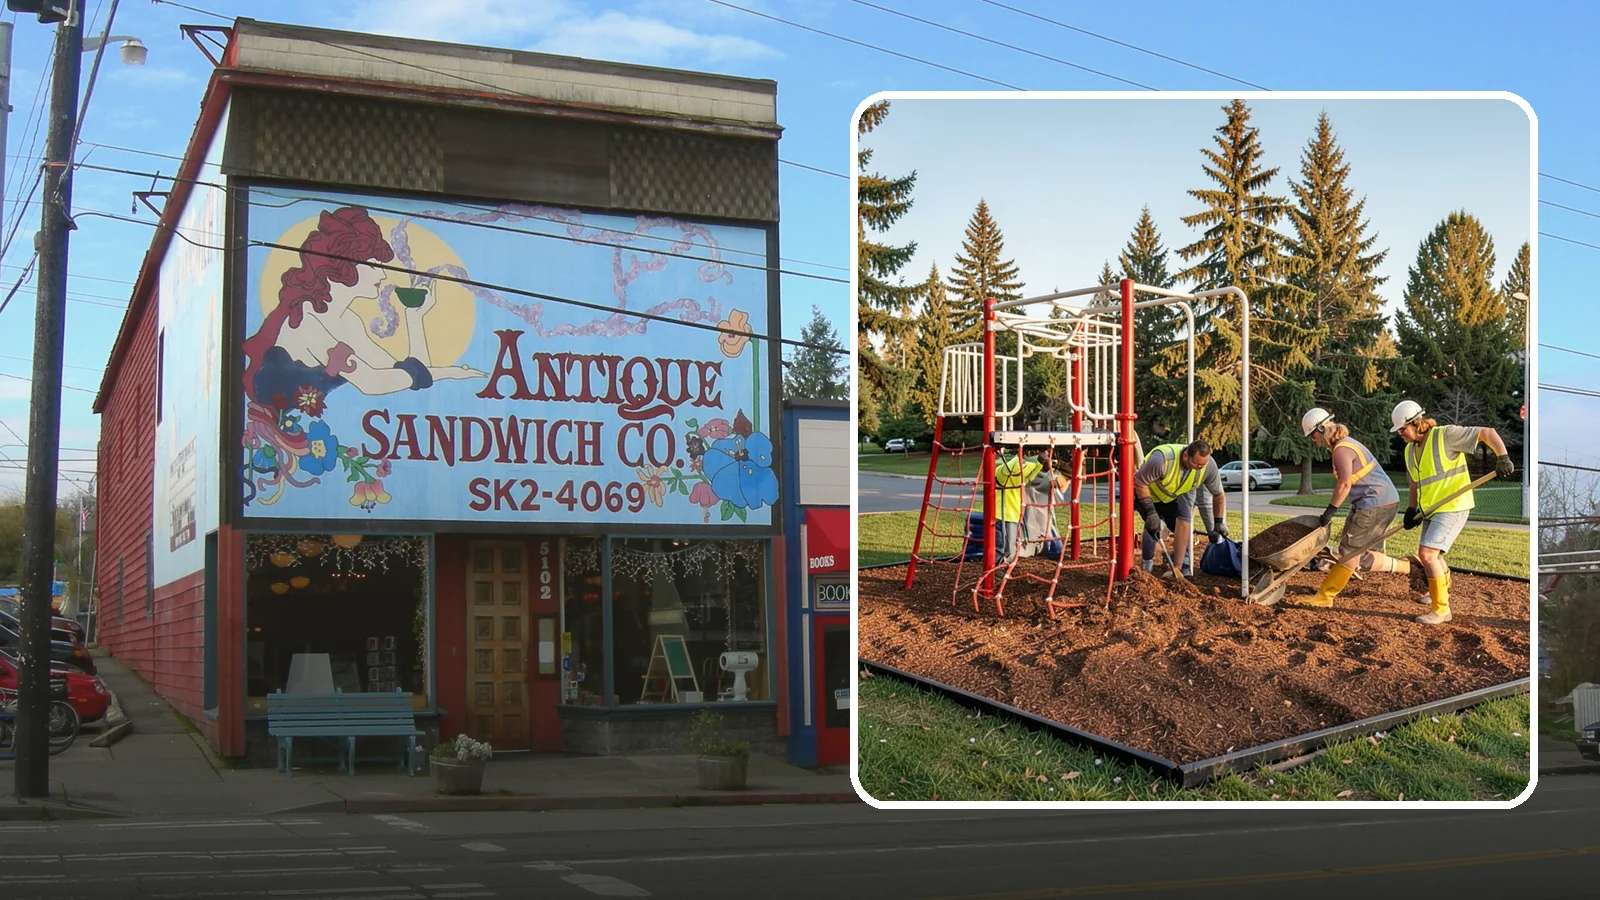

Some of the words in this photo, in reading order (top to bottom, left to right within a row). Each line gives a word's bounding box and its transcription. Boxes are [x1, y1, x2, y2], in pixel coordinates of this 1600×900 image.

[476, 329, 723, 420] ANTIQUE
[361, 409, 604, 467] SANDWICH
[617, 421, 685, 469] CO.
[468, 477, 645, 513] SK2-4069
[539, 541, 552, 600] 5102
[809, 555, 835, 569] BOOKS
